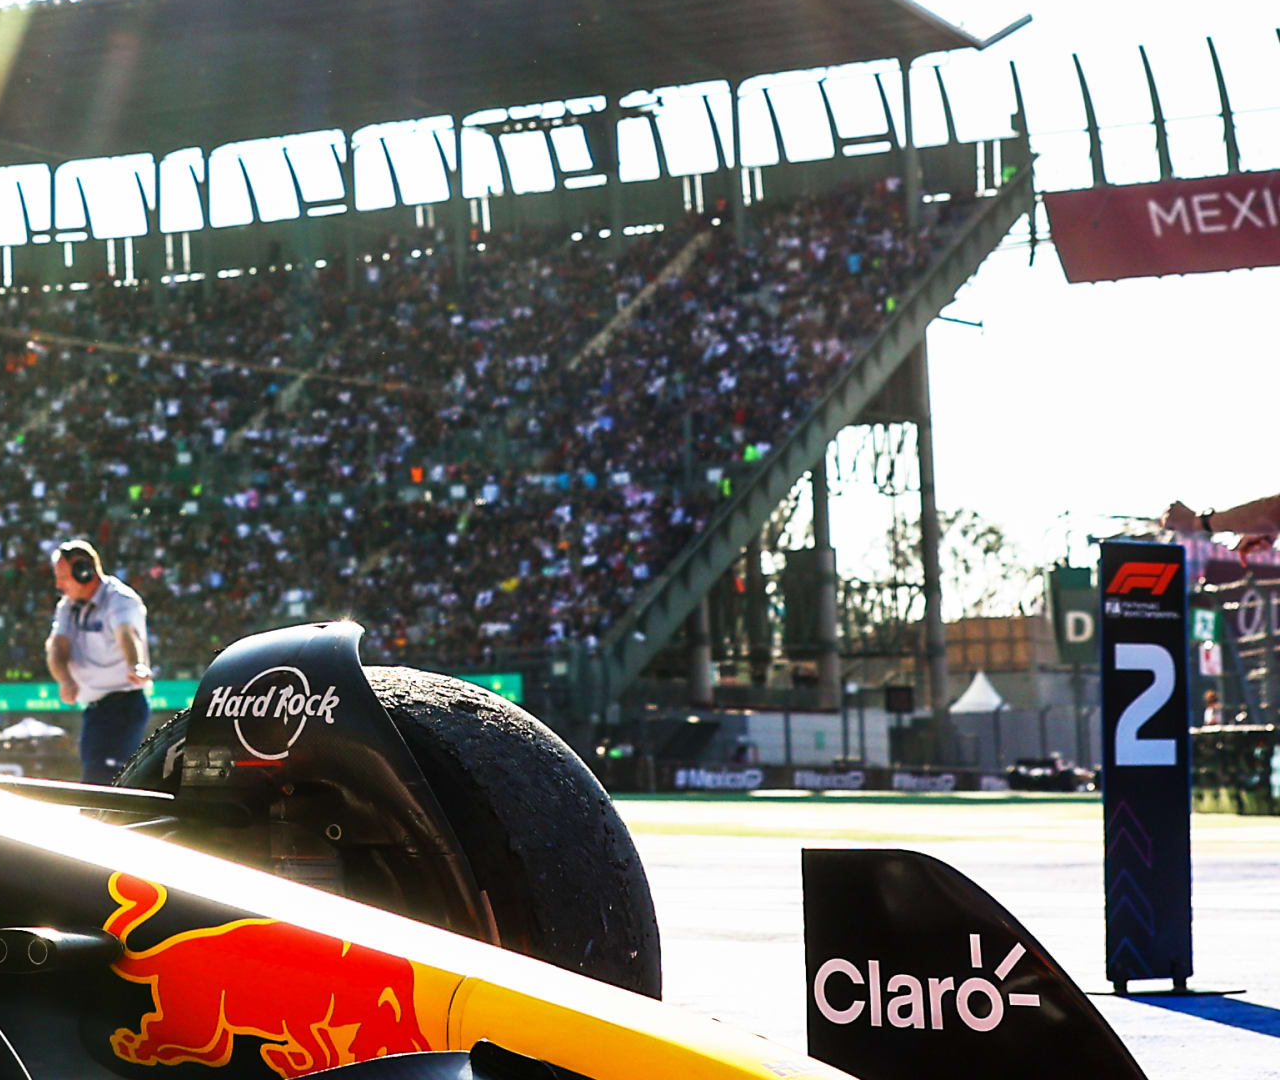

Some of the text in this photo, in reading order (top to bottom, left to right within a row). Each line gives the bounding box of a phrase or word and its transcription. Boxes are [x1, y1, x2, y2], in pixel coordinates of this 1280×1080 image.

[1147, 186, 1280, 238] MEXI
[1064, 611, 1095, 643] D
[205, 684, 341, 725] Hard Rock
[1114, 642, 1177, 766] 2
